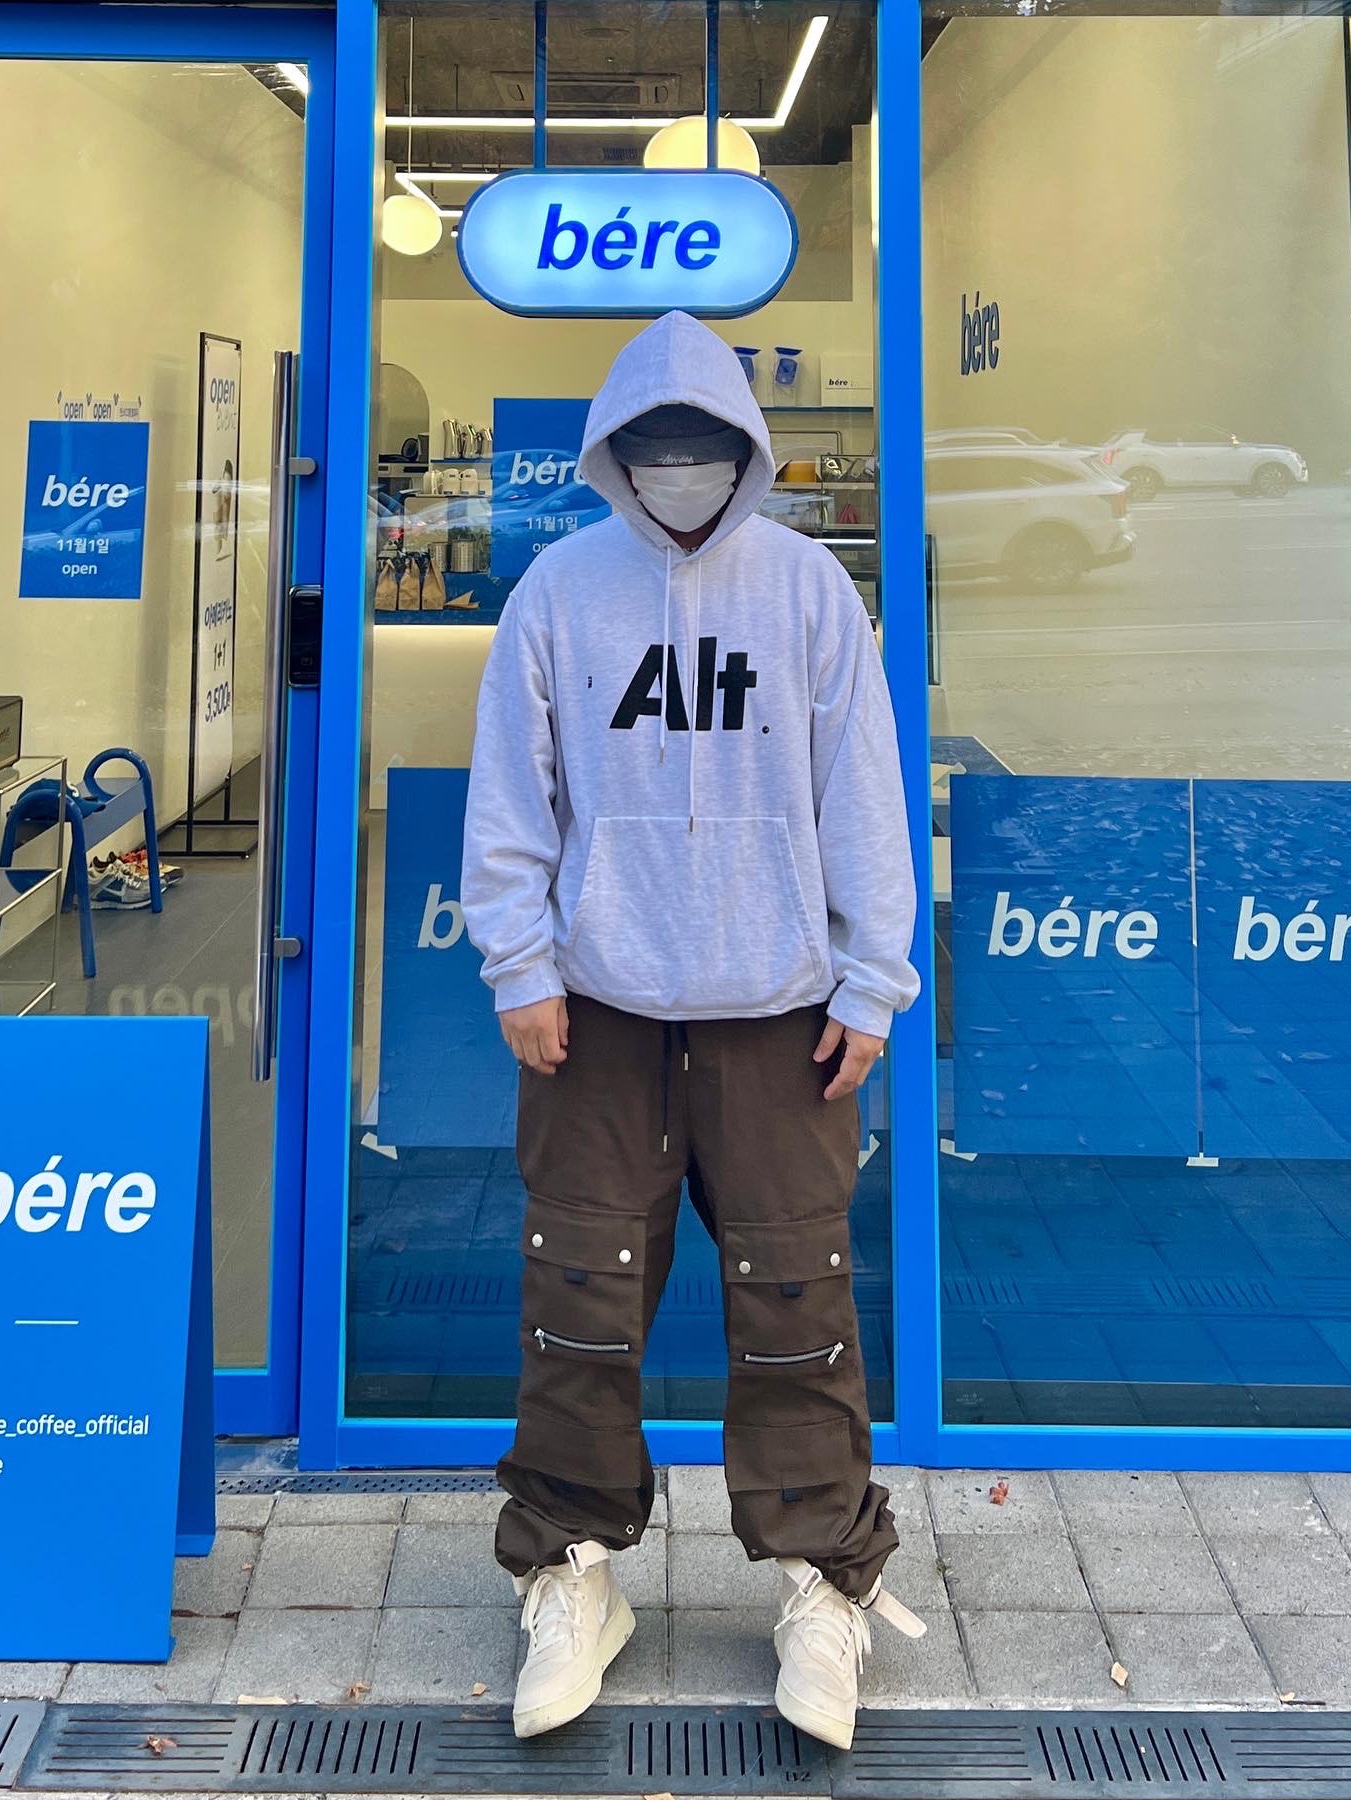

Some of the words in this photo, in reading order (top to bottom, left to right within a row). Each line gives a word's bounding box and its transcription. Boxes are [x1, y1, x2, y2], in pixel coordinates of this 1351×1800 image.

[537, 203, 721, 270] bére
[961, 291, 1000, 375] bére
[64, 403, 84, 421] open
[93, 403, 112, 421] open
[210, 378, 236, 412] open
[42, 475, 129, 508] bére
[62, 563, 97, 577] open
[987, 891, 1158, 960] bére
